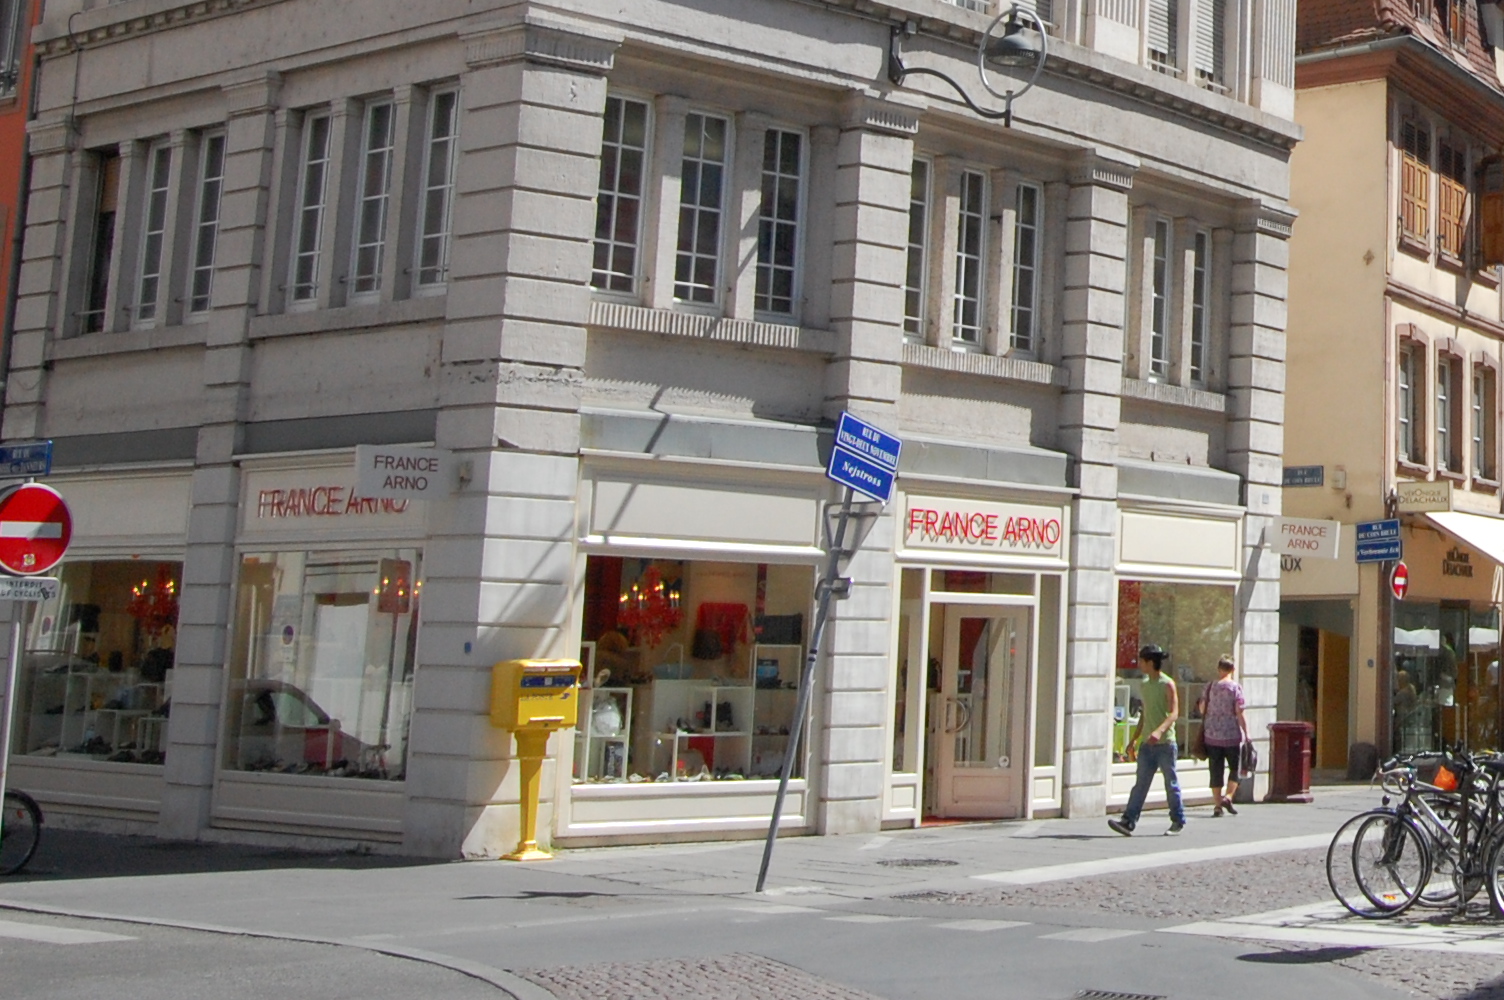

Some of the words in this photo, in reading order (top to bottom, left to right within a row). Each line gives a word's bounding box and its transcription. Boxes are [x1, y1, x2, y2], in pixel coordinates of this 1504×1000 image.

[374, 455, 439, 473] FRANCE
[842, 461, 882, 487] Nejstross
[383, 476, 428, 491] ARNO
[257, 487, 345, 518] FRANCE
[910, 508, 998, 540] FRANCE
[1004, 516, 1060, 544] ARNO
[1281, 523, 1326, 537] FRANCE
[1287, 539, 1319, 550] ARNO
